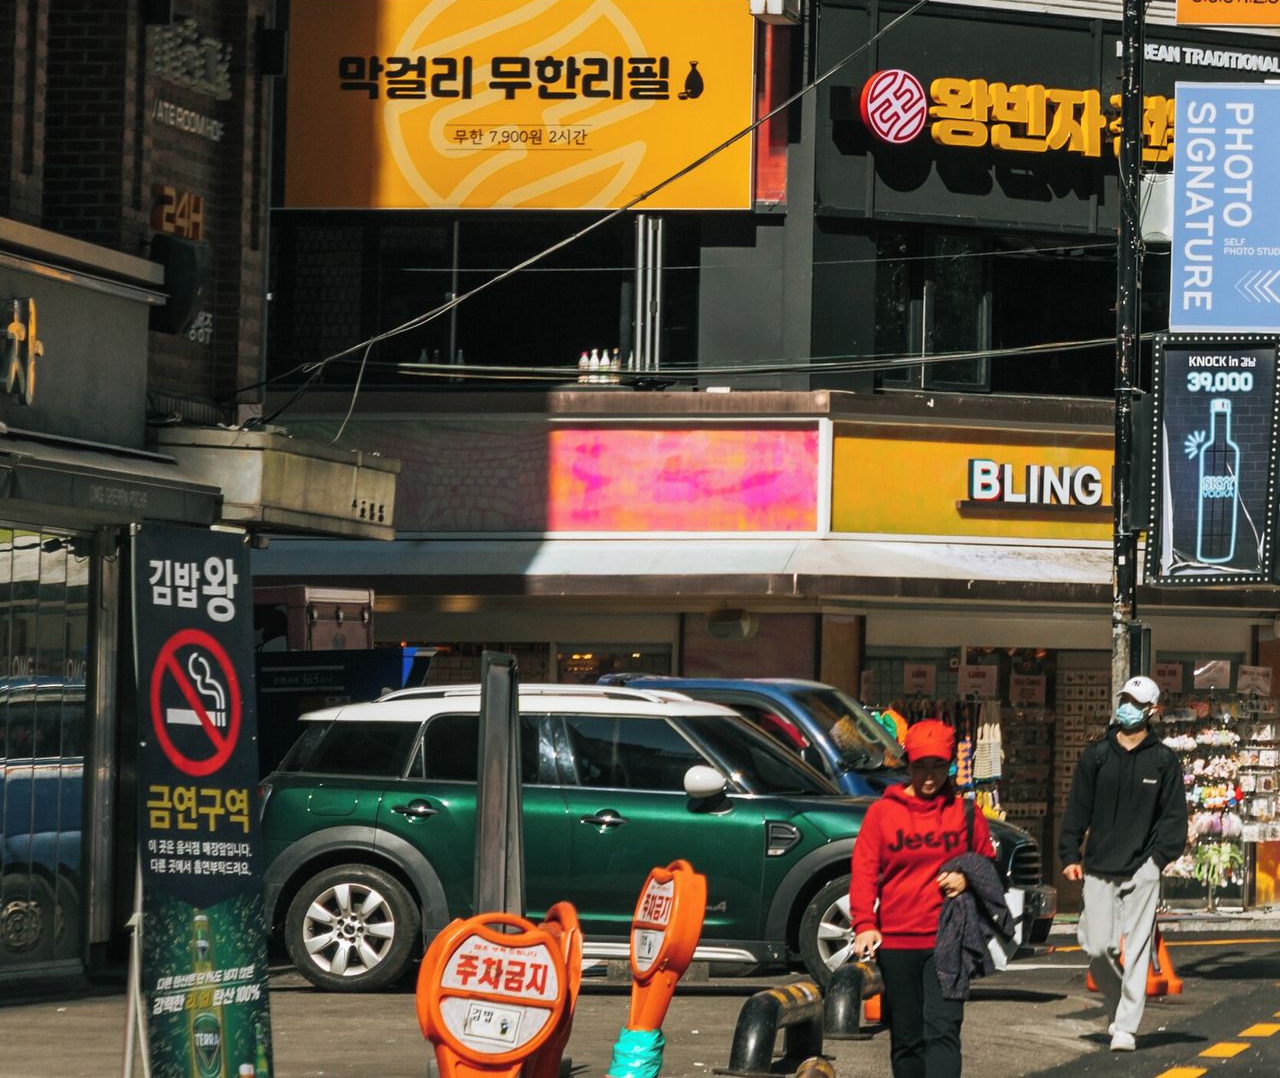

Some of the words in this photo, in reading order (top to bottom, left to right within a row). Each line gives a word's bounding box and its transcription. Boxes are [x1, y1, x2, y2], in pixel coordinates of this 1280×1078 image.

[339, 56, 472, 100] 막걸리
[489, 55, 670, 101] 무한리필
[929, 77, 1107, 158] 왕빈자
[453, 127, 484, 146] 무한
[548, 128, 588, 146] 2시간
[1223, 103, 1254, 227] PHOTO
[1183, 102, 1216, 311] SIGNATURE
[1224, 238, 1246, 246] SELF
[1224, 247, 1254, 255] PHOTO
[1188, 356, 1227, 367] KNOCK
[1229, 356, 1239, 367] in
[973, 459, 1102, 506] BLING
[1202, 476, 1235, 491] SKYY
[1202, 489, 1234, 498] VODKA
[147, 785, 250, 833] 금연구역
[148, 840, 156, 853] 이
[176, 840, 200, 855] 음식점
[887, 828, 960, 853] Jeep
[150, 859, 166, 873] 다른
[643, 893, 672, 921] 주차금지
[456, 954, 549, 995] 주차금지
